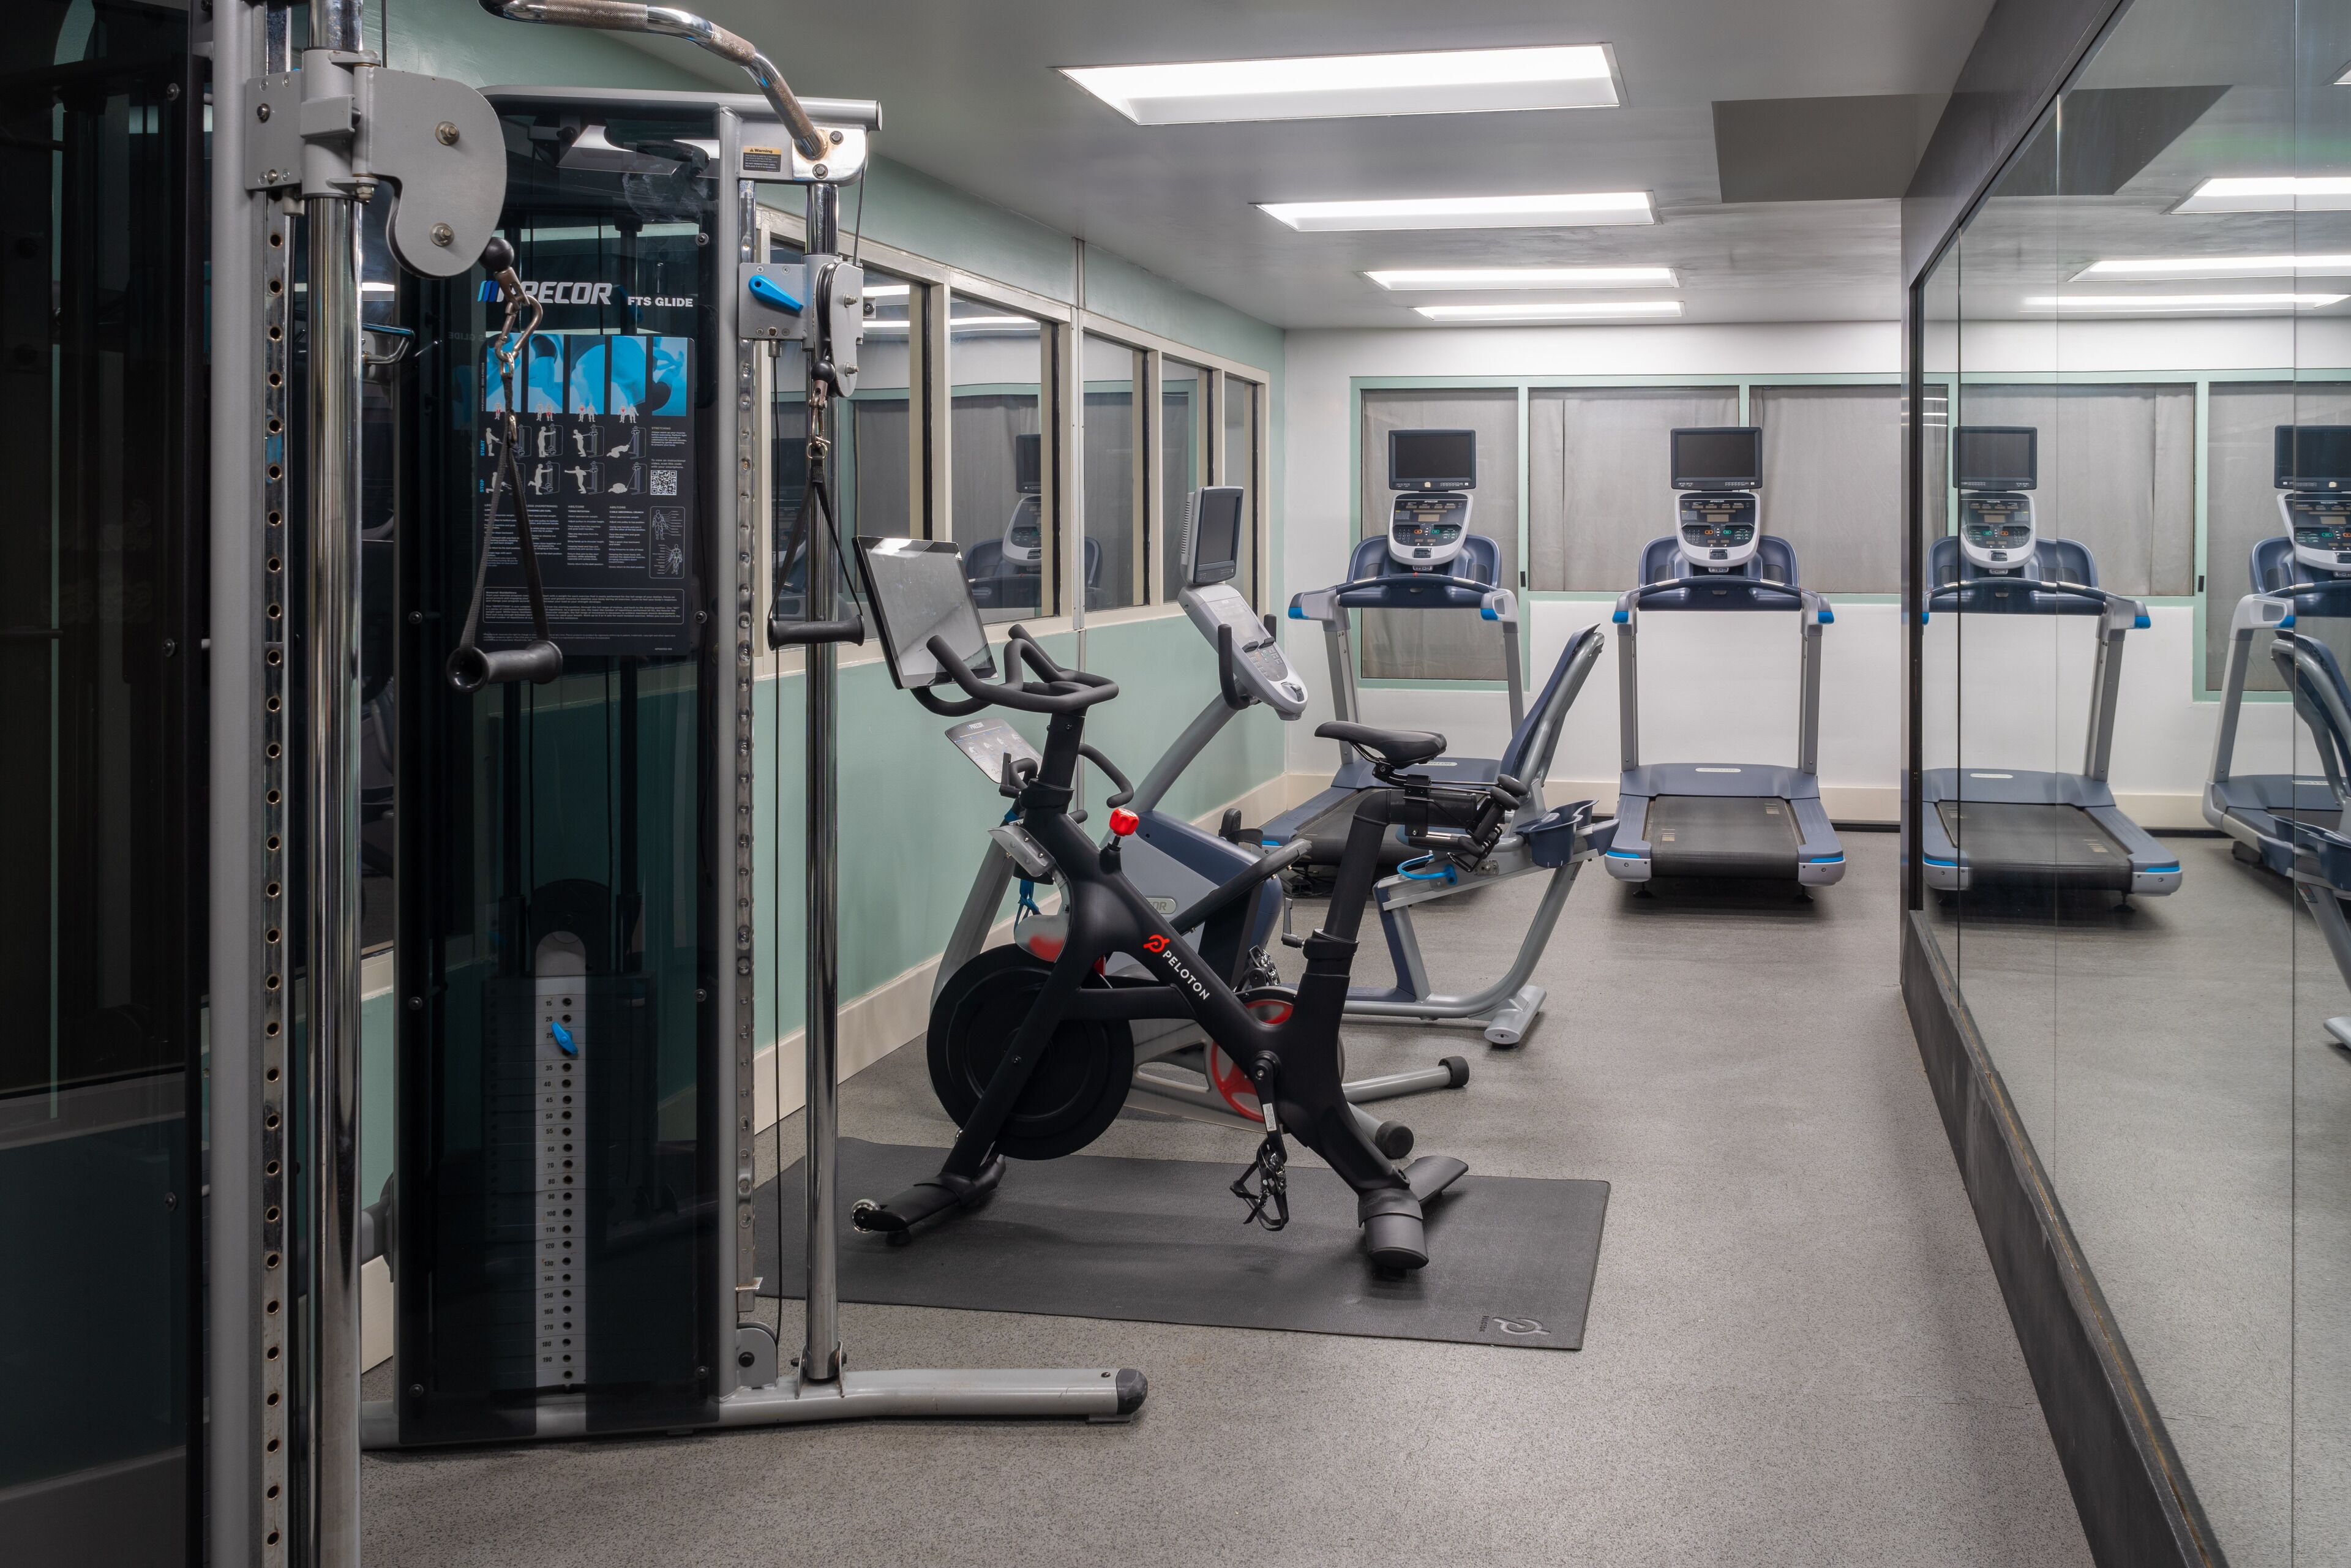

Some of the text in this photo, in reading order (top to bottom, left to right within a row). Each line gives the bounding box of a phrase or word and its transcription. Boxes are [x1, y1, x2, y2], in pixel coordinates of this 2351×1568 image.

[628, 296, 651, 306] FTS
[654, 297, 693, 307] GLIDE
[1163, 950, 1210, 1000] PELOTON
